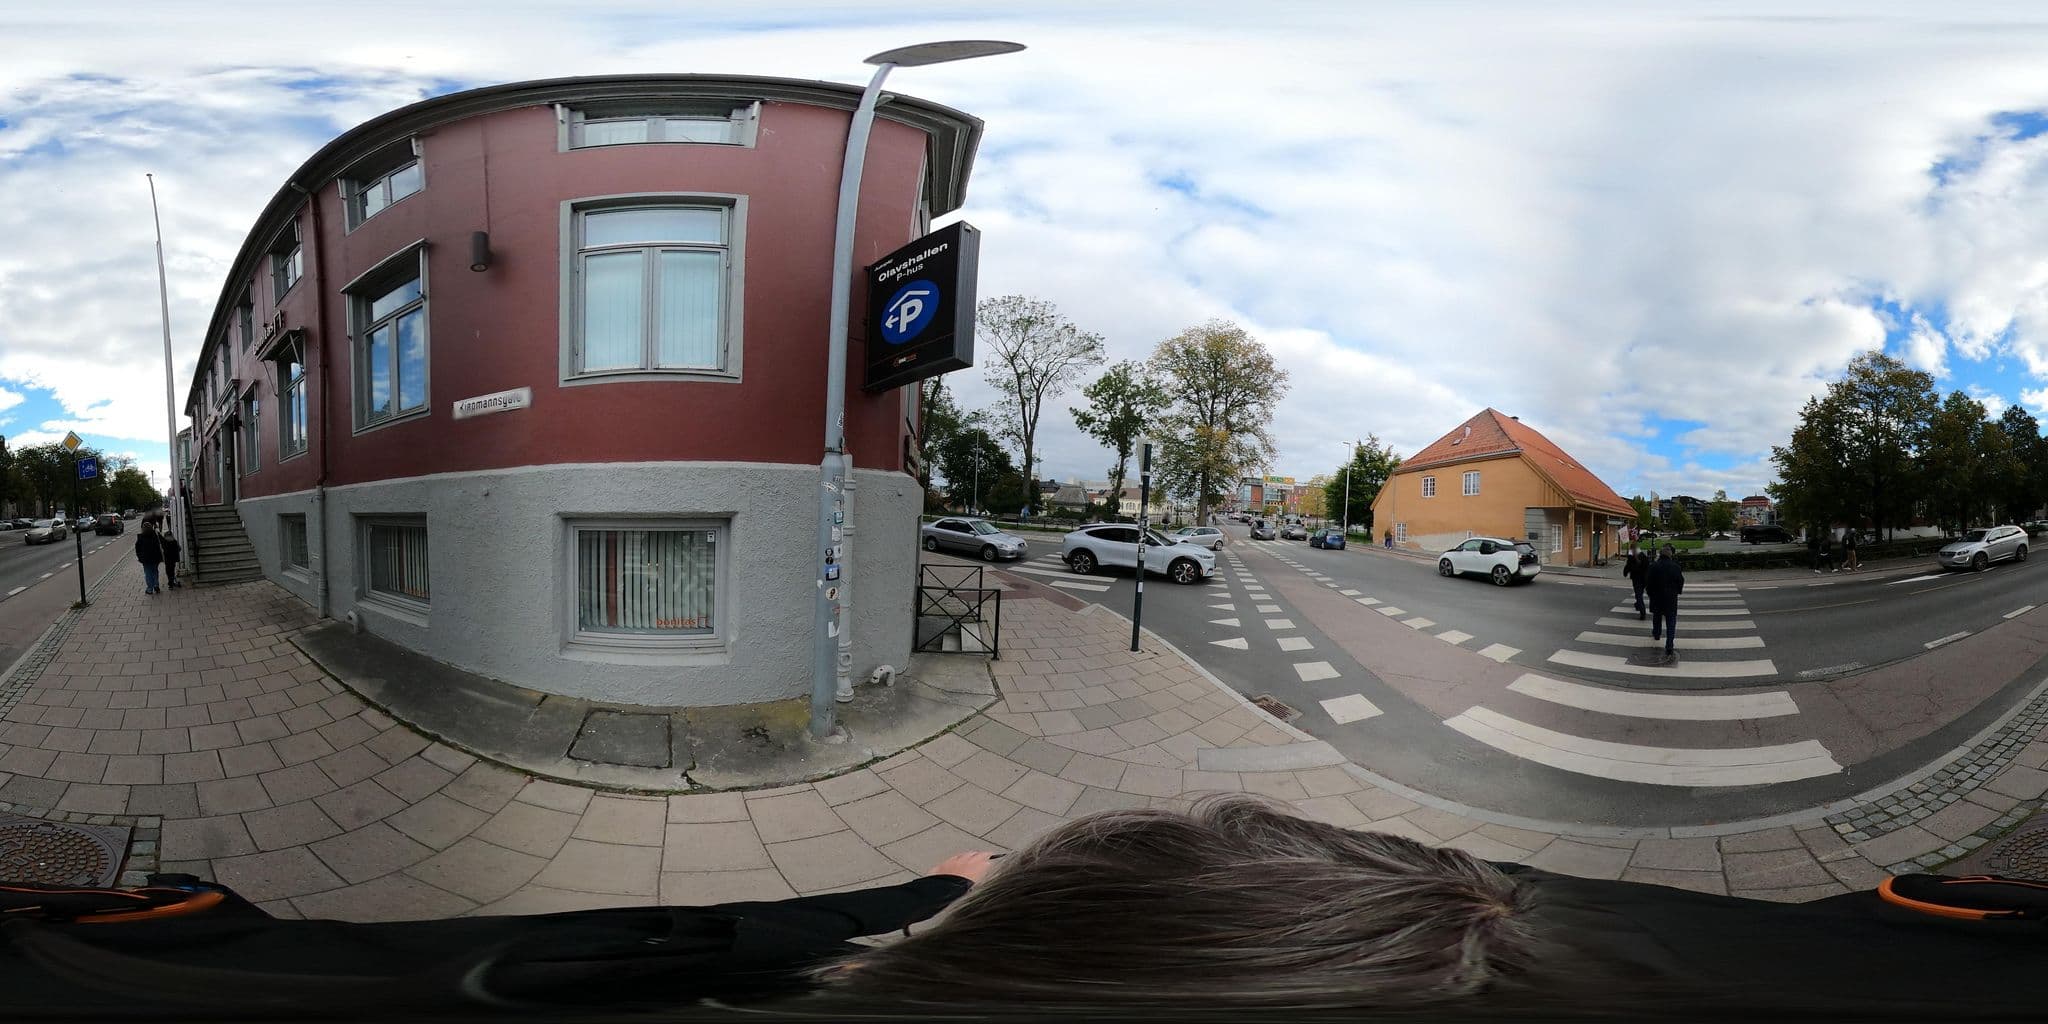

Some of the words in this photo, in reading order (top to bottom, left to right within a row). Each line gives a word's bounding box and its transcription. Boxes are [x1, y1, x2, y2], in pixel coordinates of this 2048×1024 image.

[878, 243, 948, 282] Olavshallen
[896, 263, 924, 281] P-hus
[899, 299, 923, 333] P
